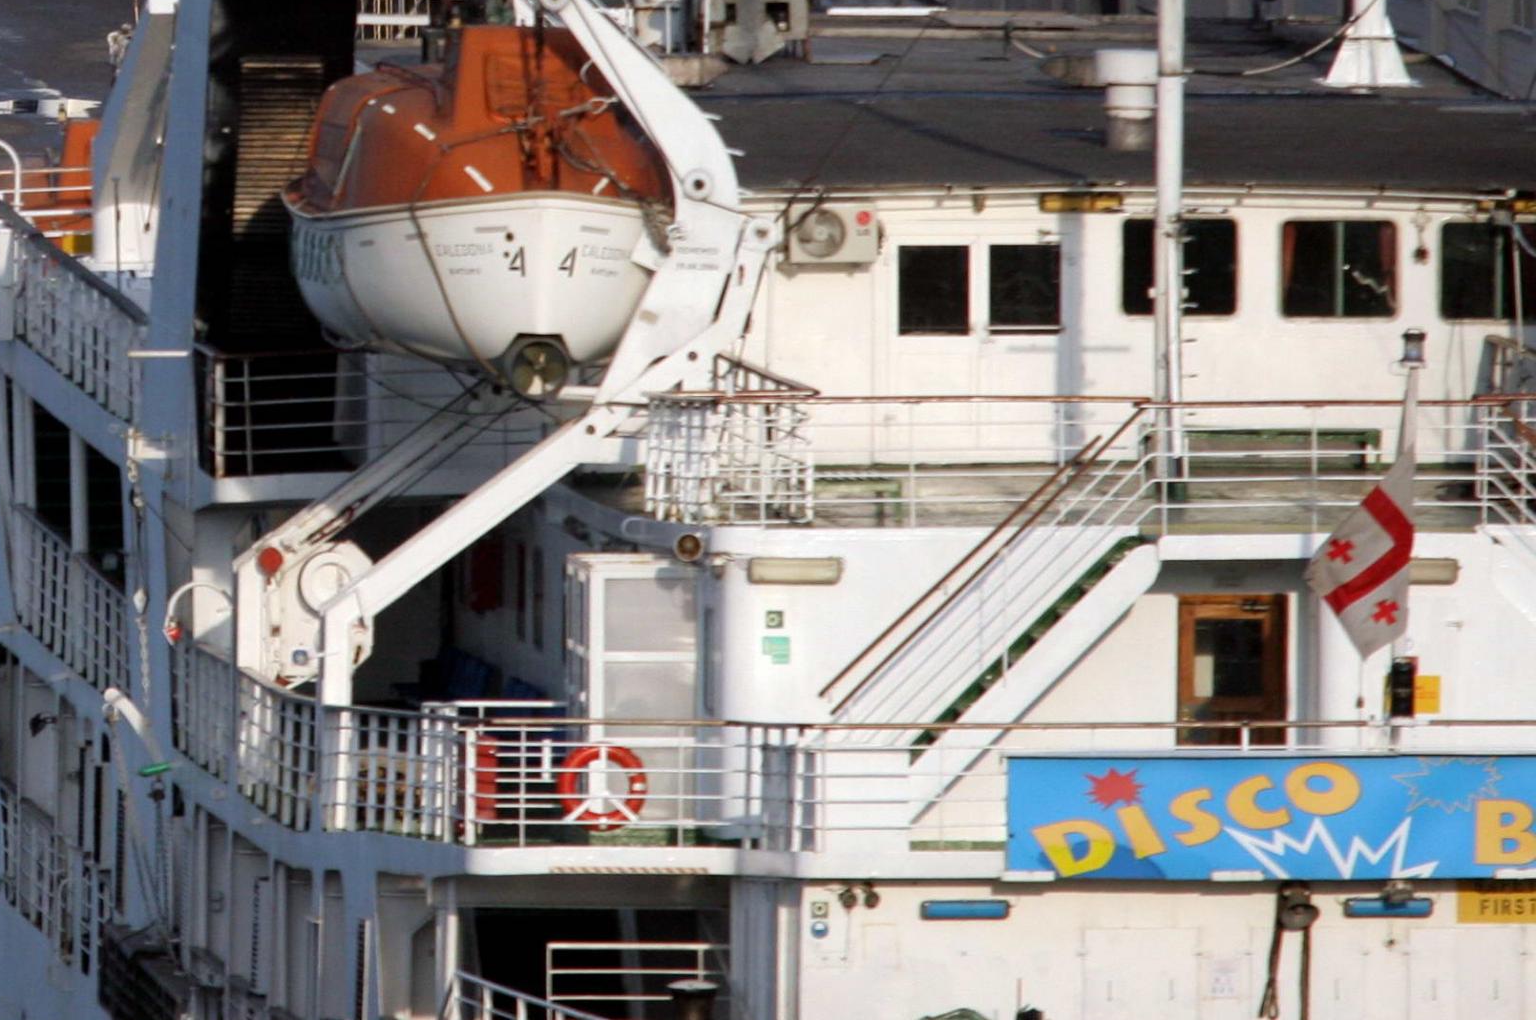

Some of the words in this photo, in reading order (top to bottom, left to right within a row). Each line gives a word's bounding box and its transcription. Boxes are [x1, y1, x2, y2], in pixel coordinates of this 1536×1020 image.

[508, 246, 527, 278] 4
[558, 246, 578, 278] 4
[1032, 761, 1361, 878] DISCO
[1478, 898, 1536, 916] FIRST
